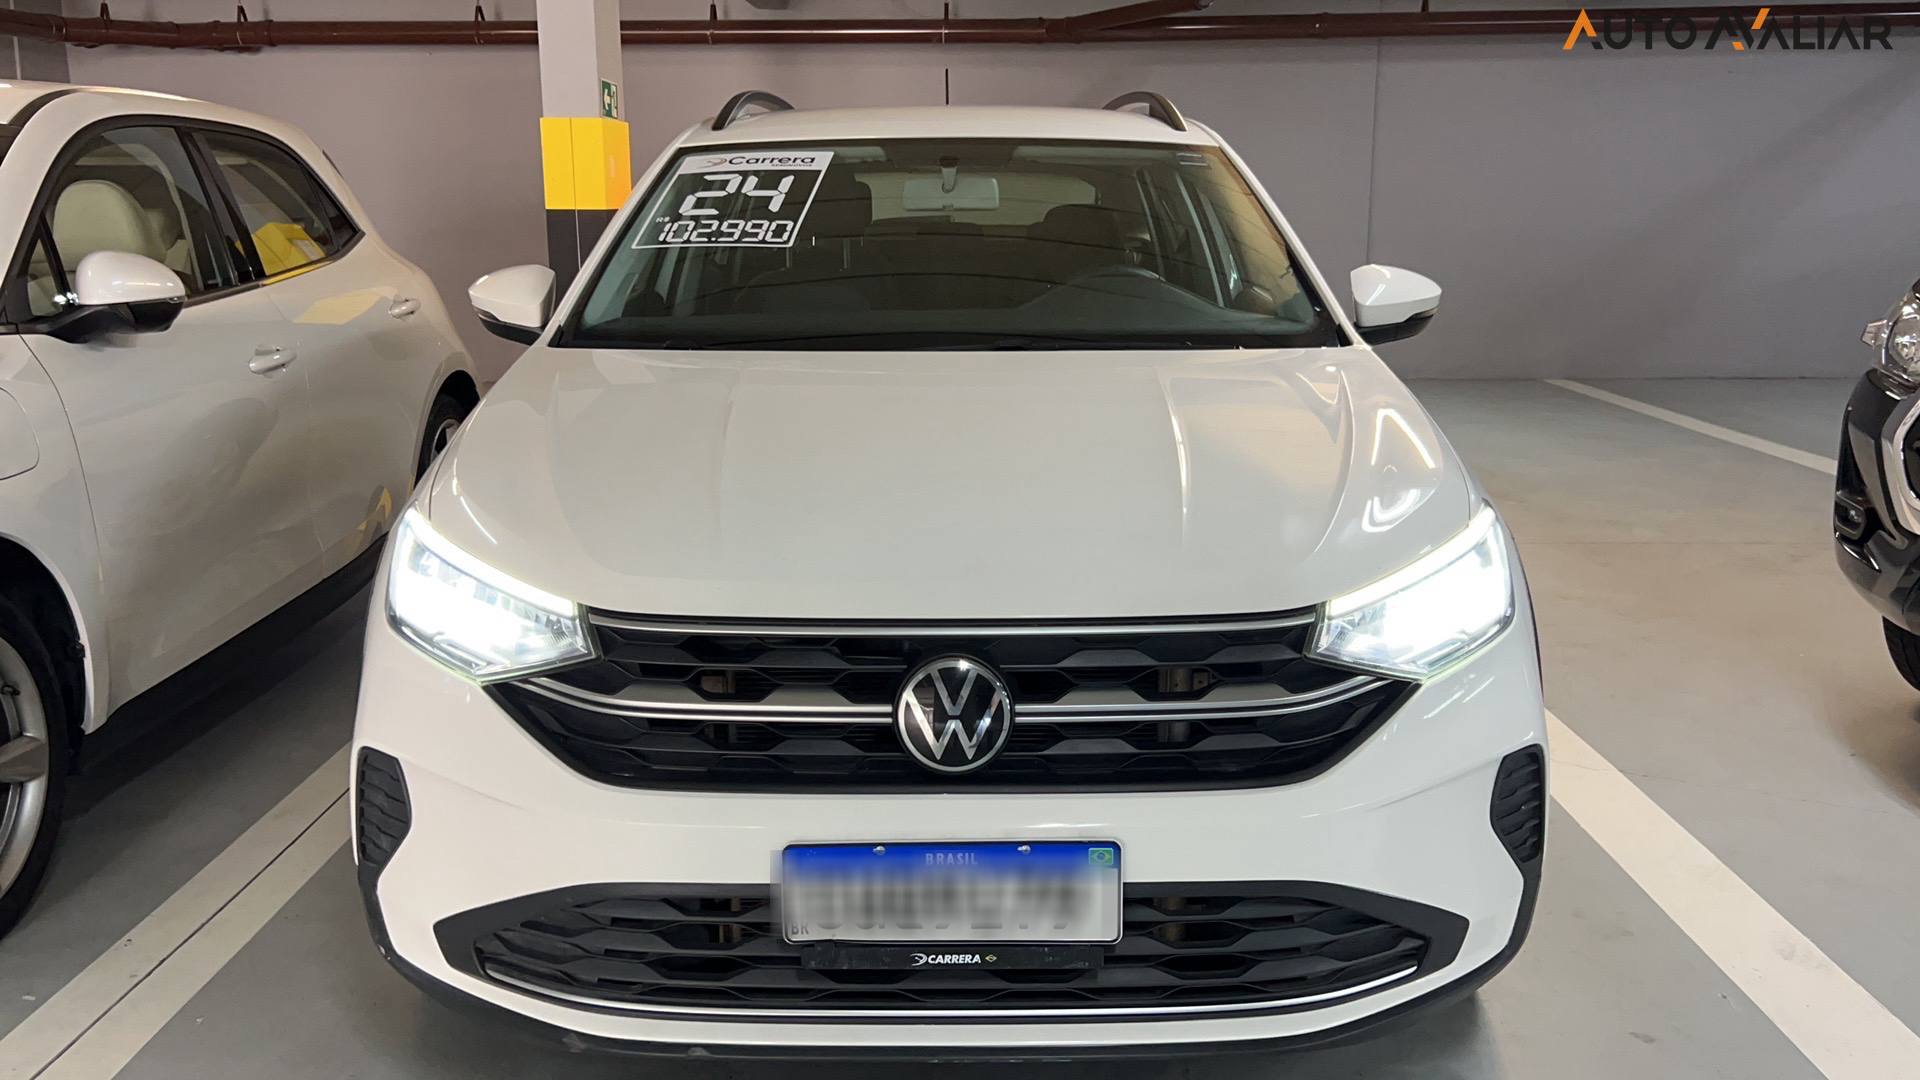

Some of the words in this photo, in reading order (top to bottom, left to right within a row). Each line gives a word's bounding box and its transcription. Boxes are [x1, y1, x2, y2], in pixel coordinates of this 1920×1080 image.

[728, 156, 816, 165] Carrera
[678, 173, 795, 216] 24
[658, 220, 794, 242] 102.990
[902, 667, 1002, 760] VW
[925, 853, 978, 866] BRASIL
[791, 922, 809, 935] BR
[928, 954, 981, 965] CARRERA
